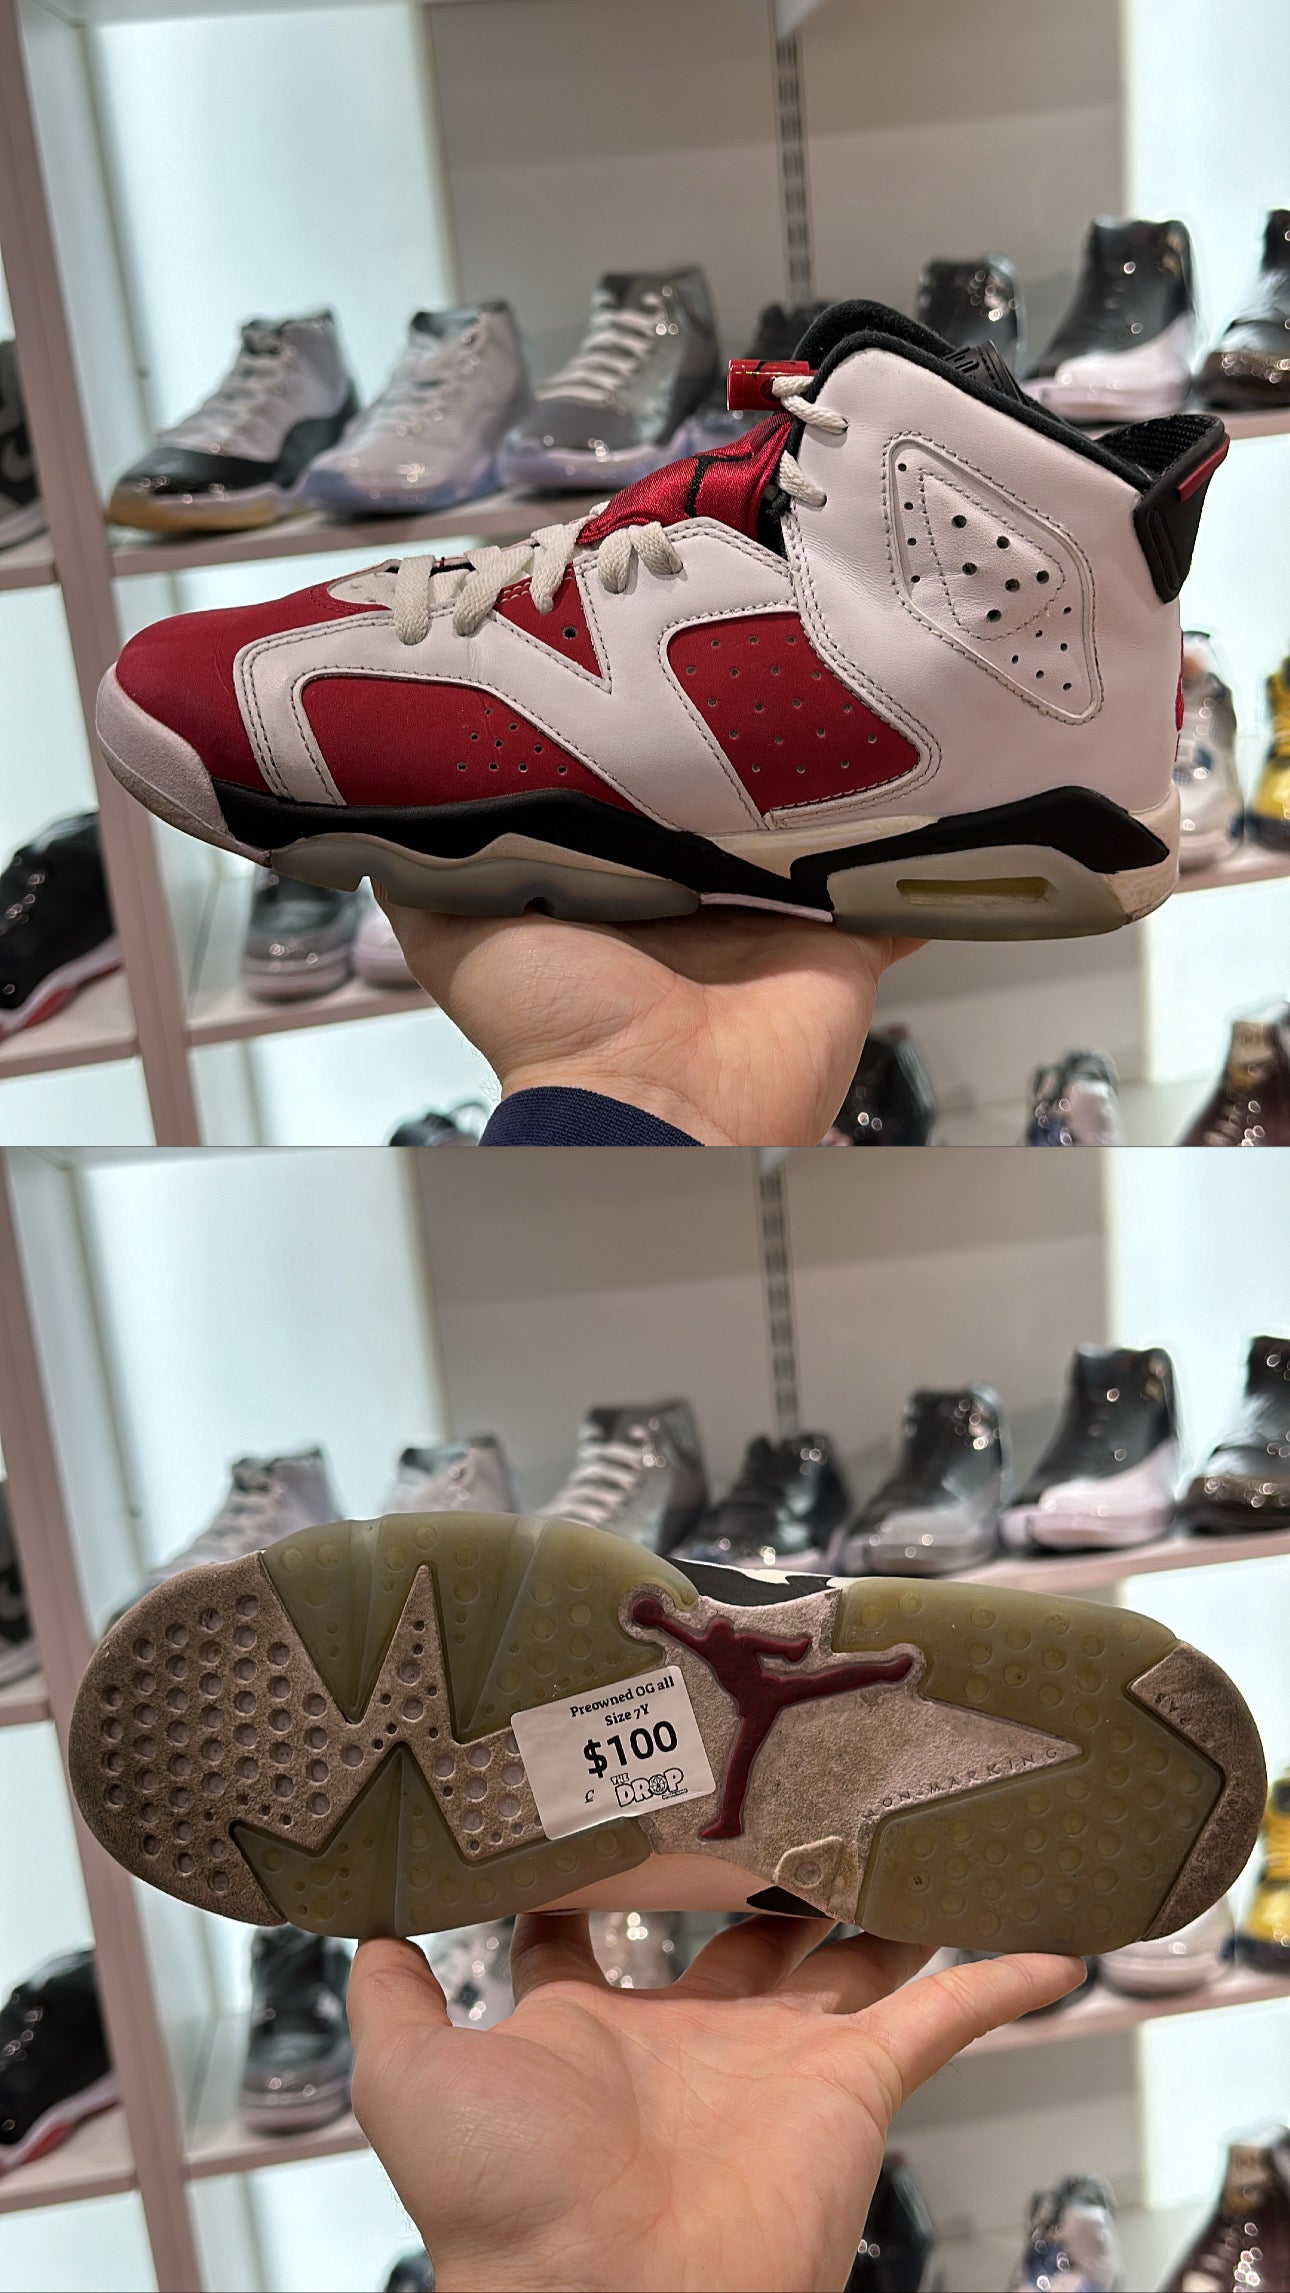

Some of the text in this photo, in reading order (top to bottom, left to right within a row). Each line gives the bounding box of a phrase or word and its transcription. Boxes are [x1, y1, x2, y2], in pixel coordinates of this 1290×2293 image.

[569, 1676, 675, 1717] Preowned OG all
[604, 1704, 650, 1726] Size 7Y
[583, 1720, 678, 1779] $100
[610, 1772, 630, 1786] THE
[615, 1767, 684, 1807] DROP
